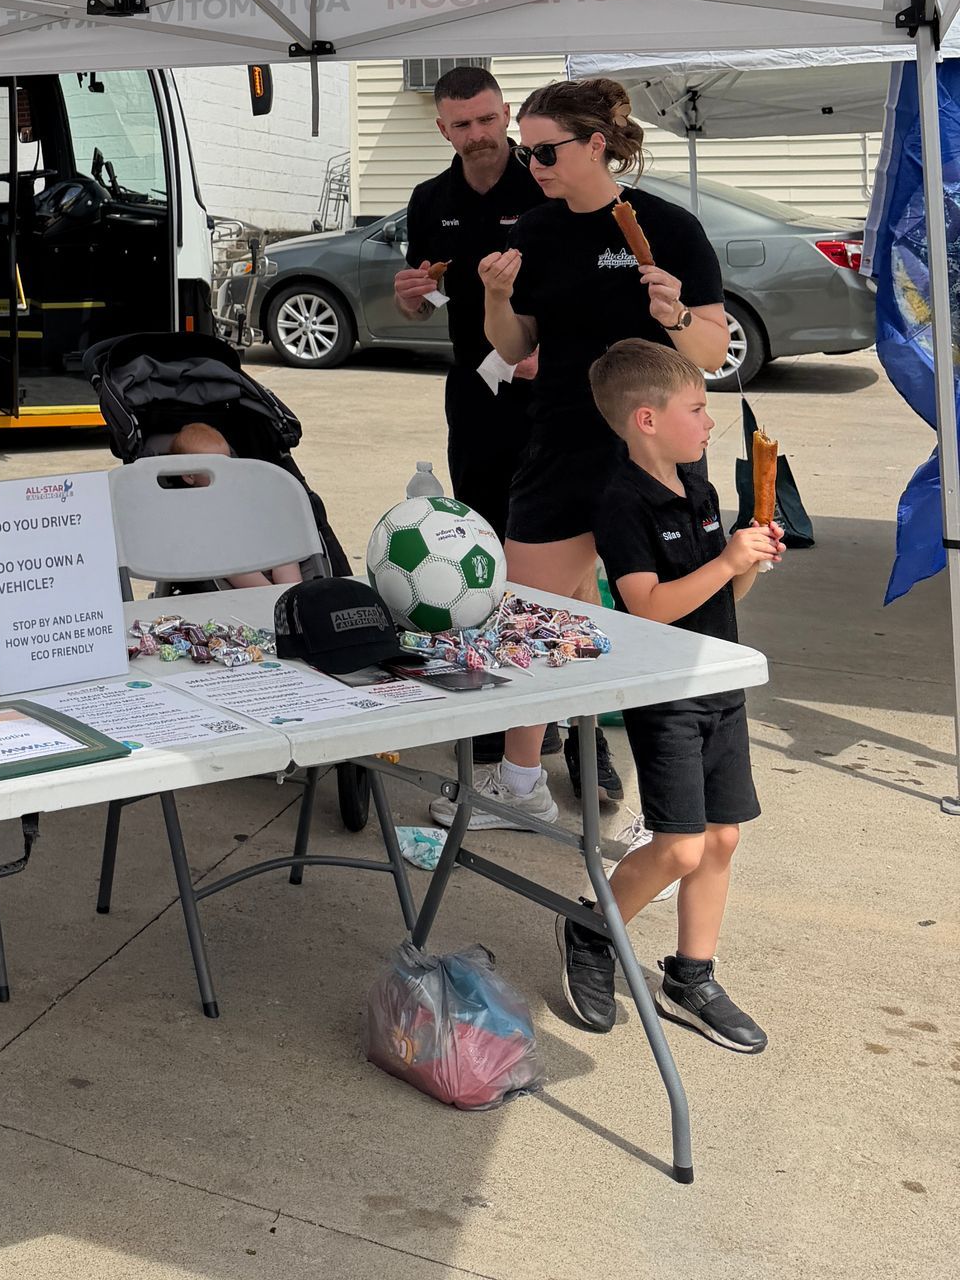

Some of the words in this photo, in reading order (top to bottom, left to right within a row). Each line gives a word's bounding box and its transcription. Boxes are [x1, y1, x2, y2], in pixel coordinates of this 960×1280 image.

[26, 485, 63, 495] ALL-STAR
[14, 519, 38, 530] YOU
[42, 514, 82, 528] DRIVE?
[17, 558, 42, 571] YOU
[45, 555, 73, 568] OWN
[76, 554, 84, 565] A
[13, 620, 36, 631] STOP
[39, 618, 50, 628] BY
[52, 614, 72, 626] AND
[75, 611, 104, 623] LEARN
[5, 637, 29, 648] HOW
[31, 634, 50, 644] YOU
[53, 631, 72, 642] CAN
[74, 628, 85, 639] BE
[87, 625, 113, 637] MORE
[31, 650, 49, 661] ECO
[52, 643, 94, 659] FRIENDLY
